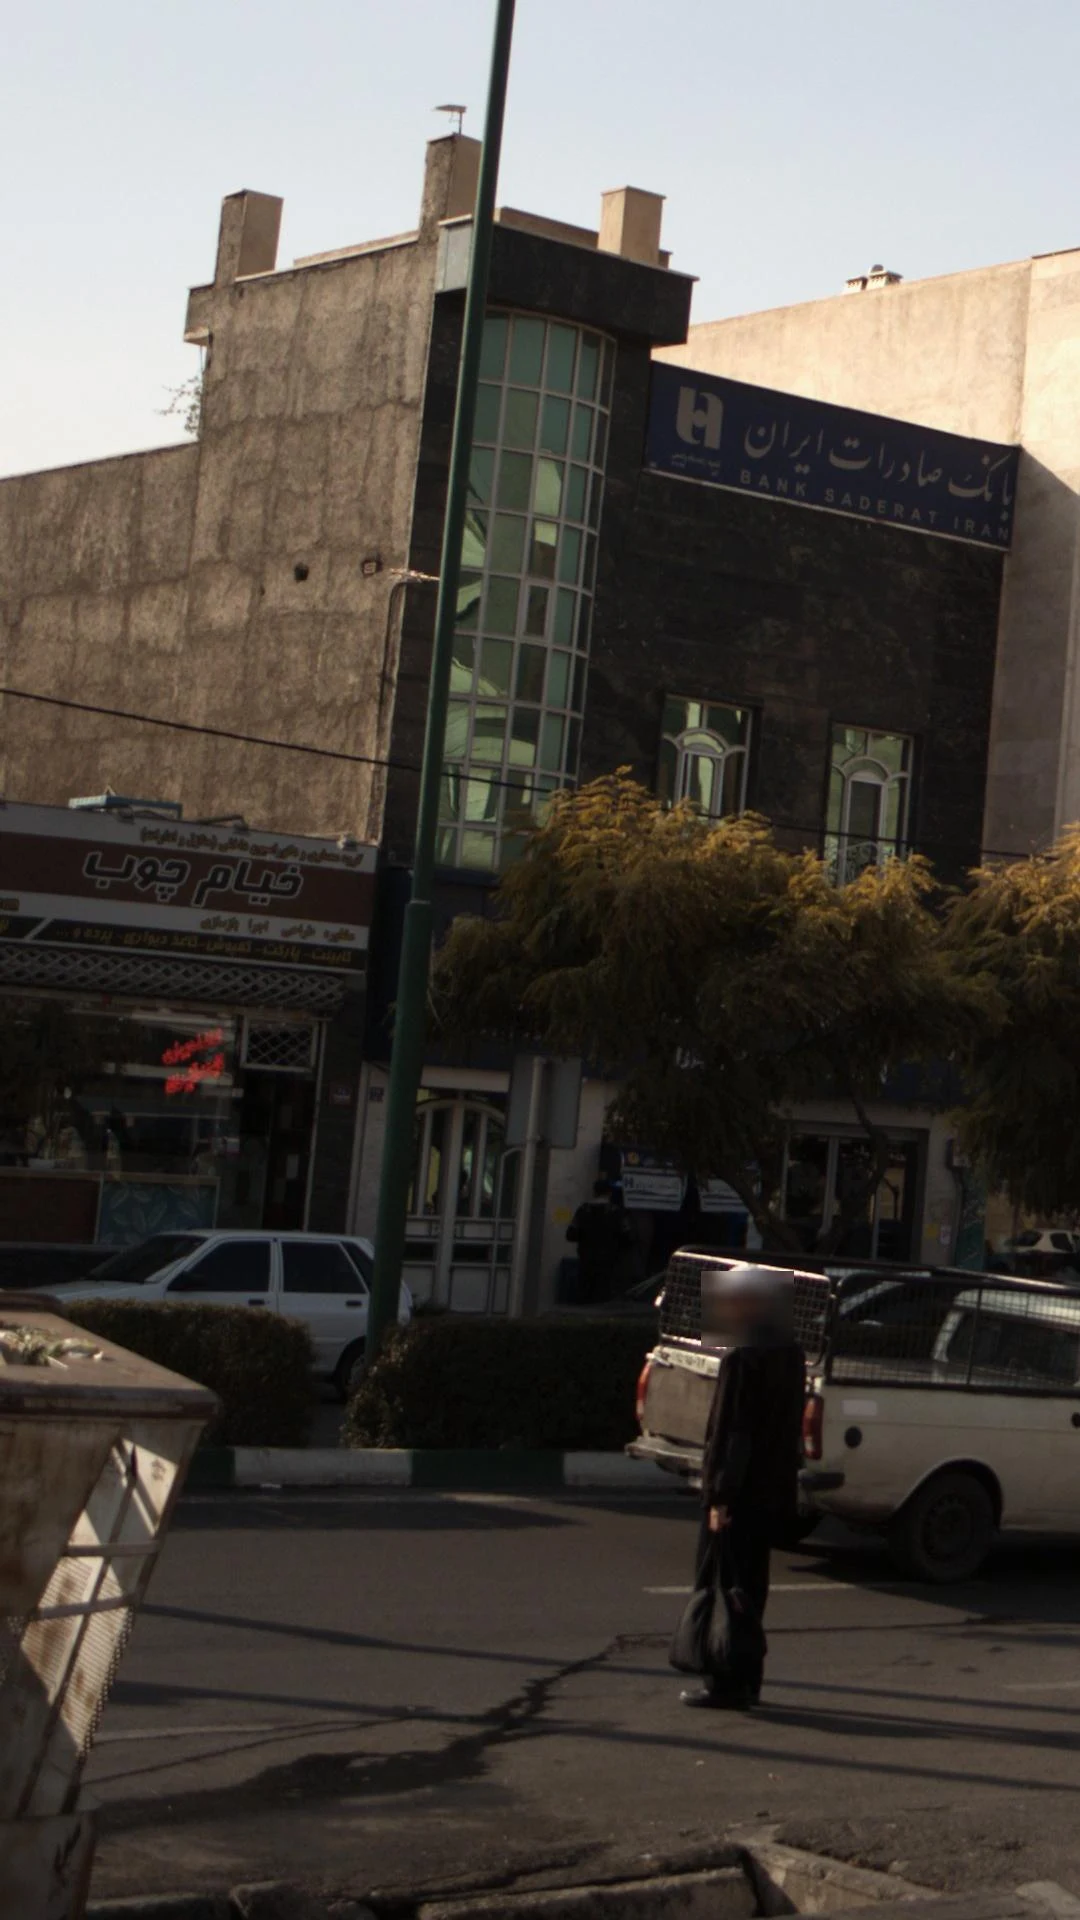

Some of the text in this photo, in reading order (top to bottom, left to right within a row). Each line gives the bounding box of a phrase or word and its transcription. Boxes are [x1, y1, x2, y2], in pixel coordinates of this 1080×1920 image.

[744, 420, 825, 475] ایران
[828, 436, 944, 488] صادرات
[740, 468, 1009, 541] BANK SADERAT IRAN
[948, 452, 1013, 521] بانک
[82, 851, 304, 907] خیام چوب
